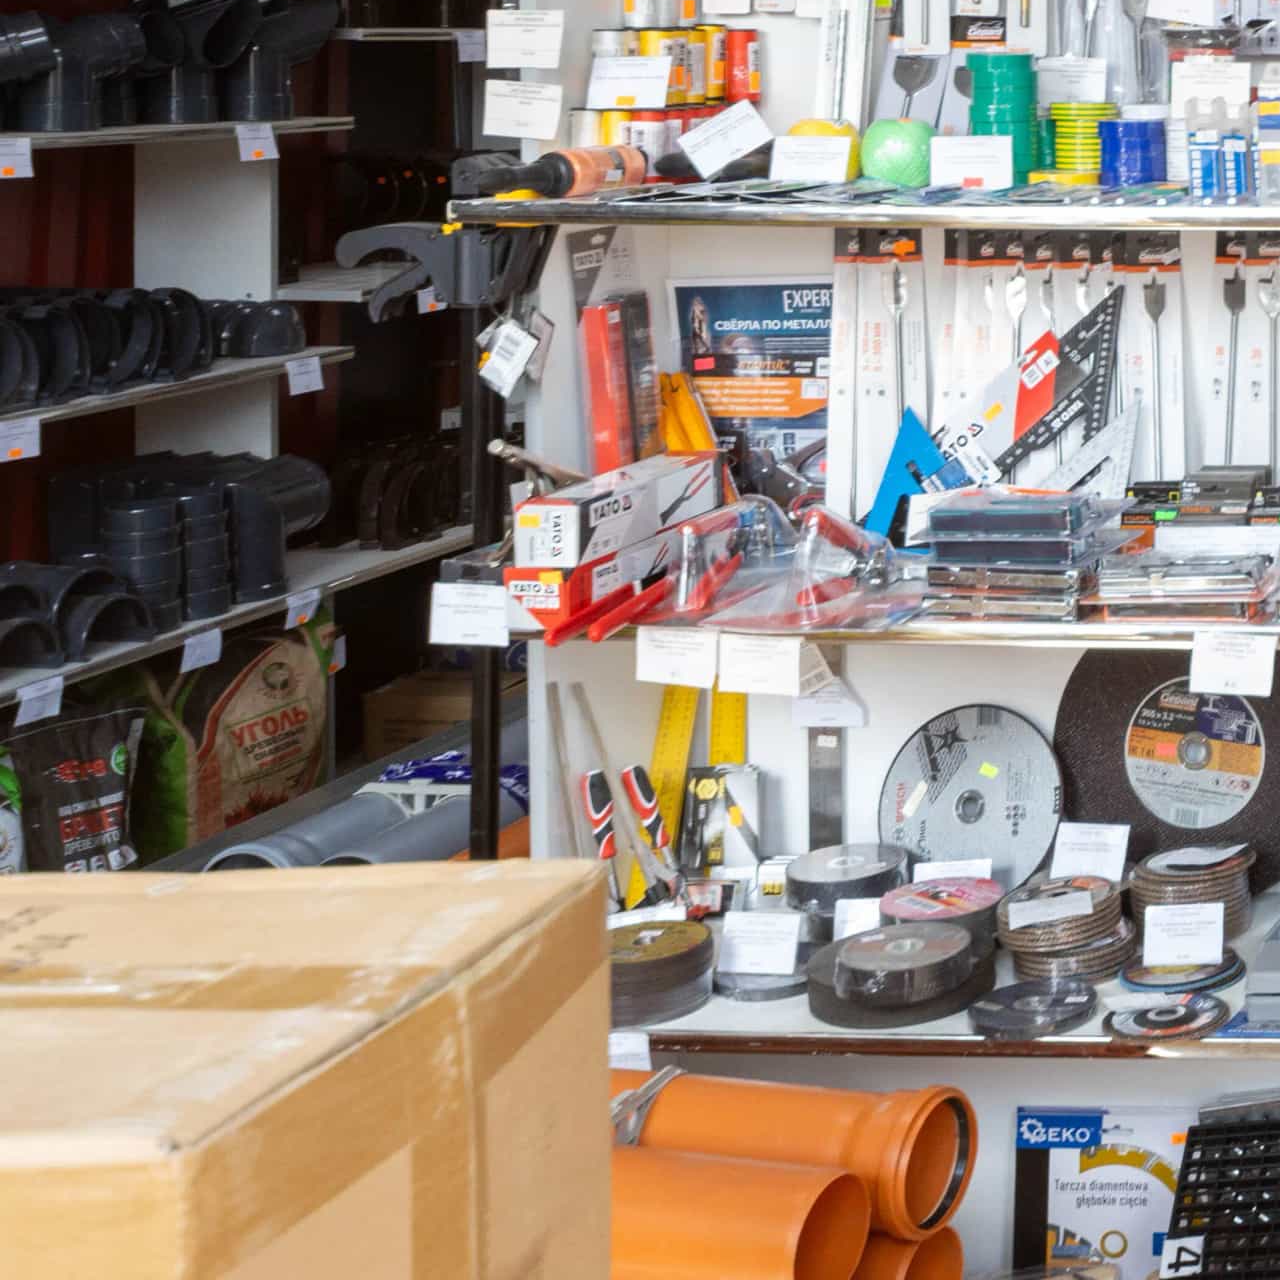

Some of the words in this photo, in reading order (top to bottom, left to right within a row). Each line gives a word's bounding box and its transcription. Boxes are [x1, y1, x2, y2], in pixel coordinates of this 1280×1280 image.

[714, 318, 760, 331] СВЁРЛА
[762, 319, 781, 330] ПО
[593, 499, 620, 519] YATO
[513, 583, 542, 593] YATO
[230, 704, 309, 750] УГОЛЬ
[1031, 1125, 1092, 1144] GEKO
[1055, 1178, 1087, 1192] Tarcza
[1089, 1178, 1149, 1192] diamentowa
